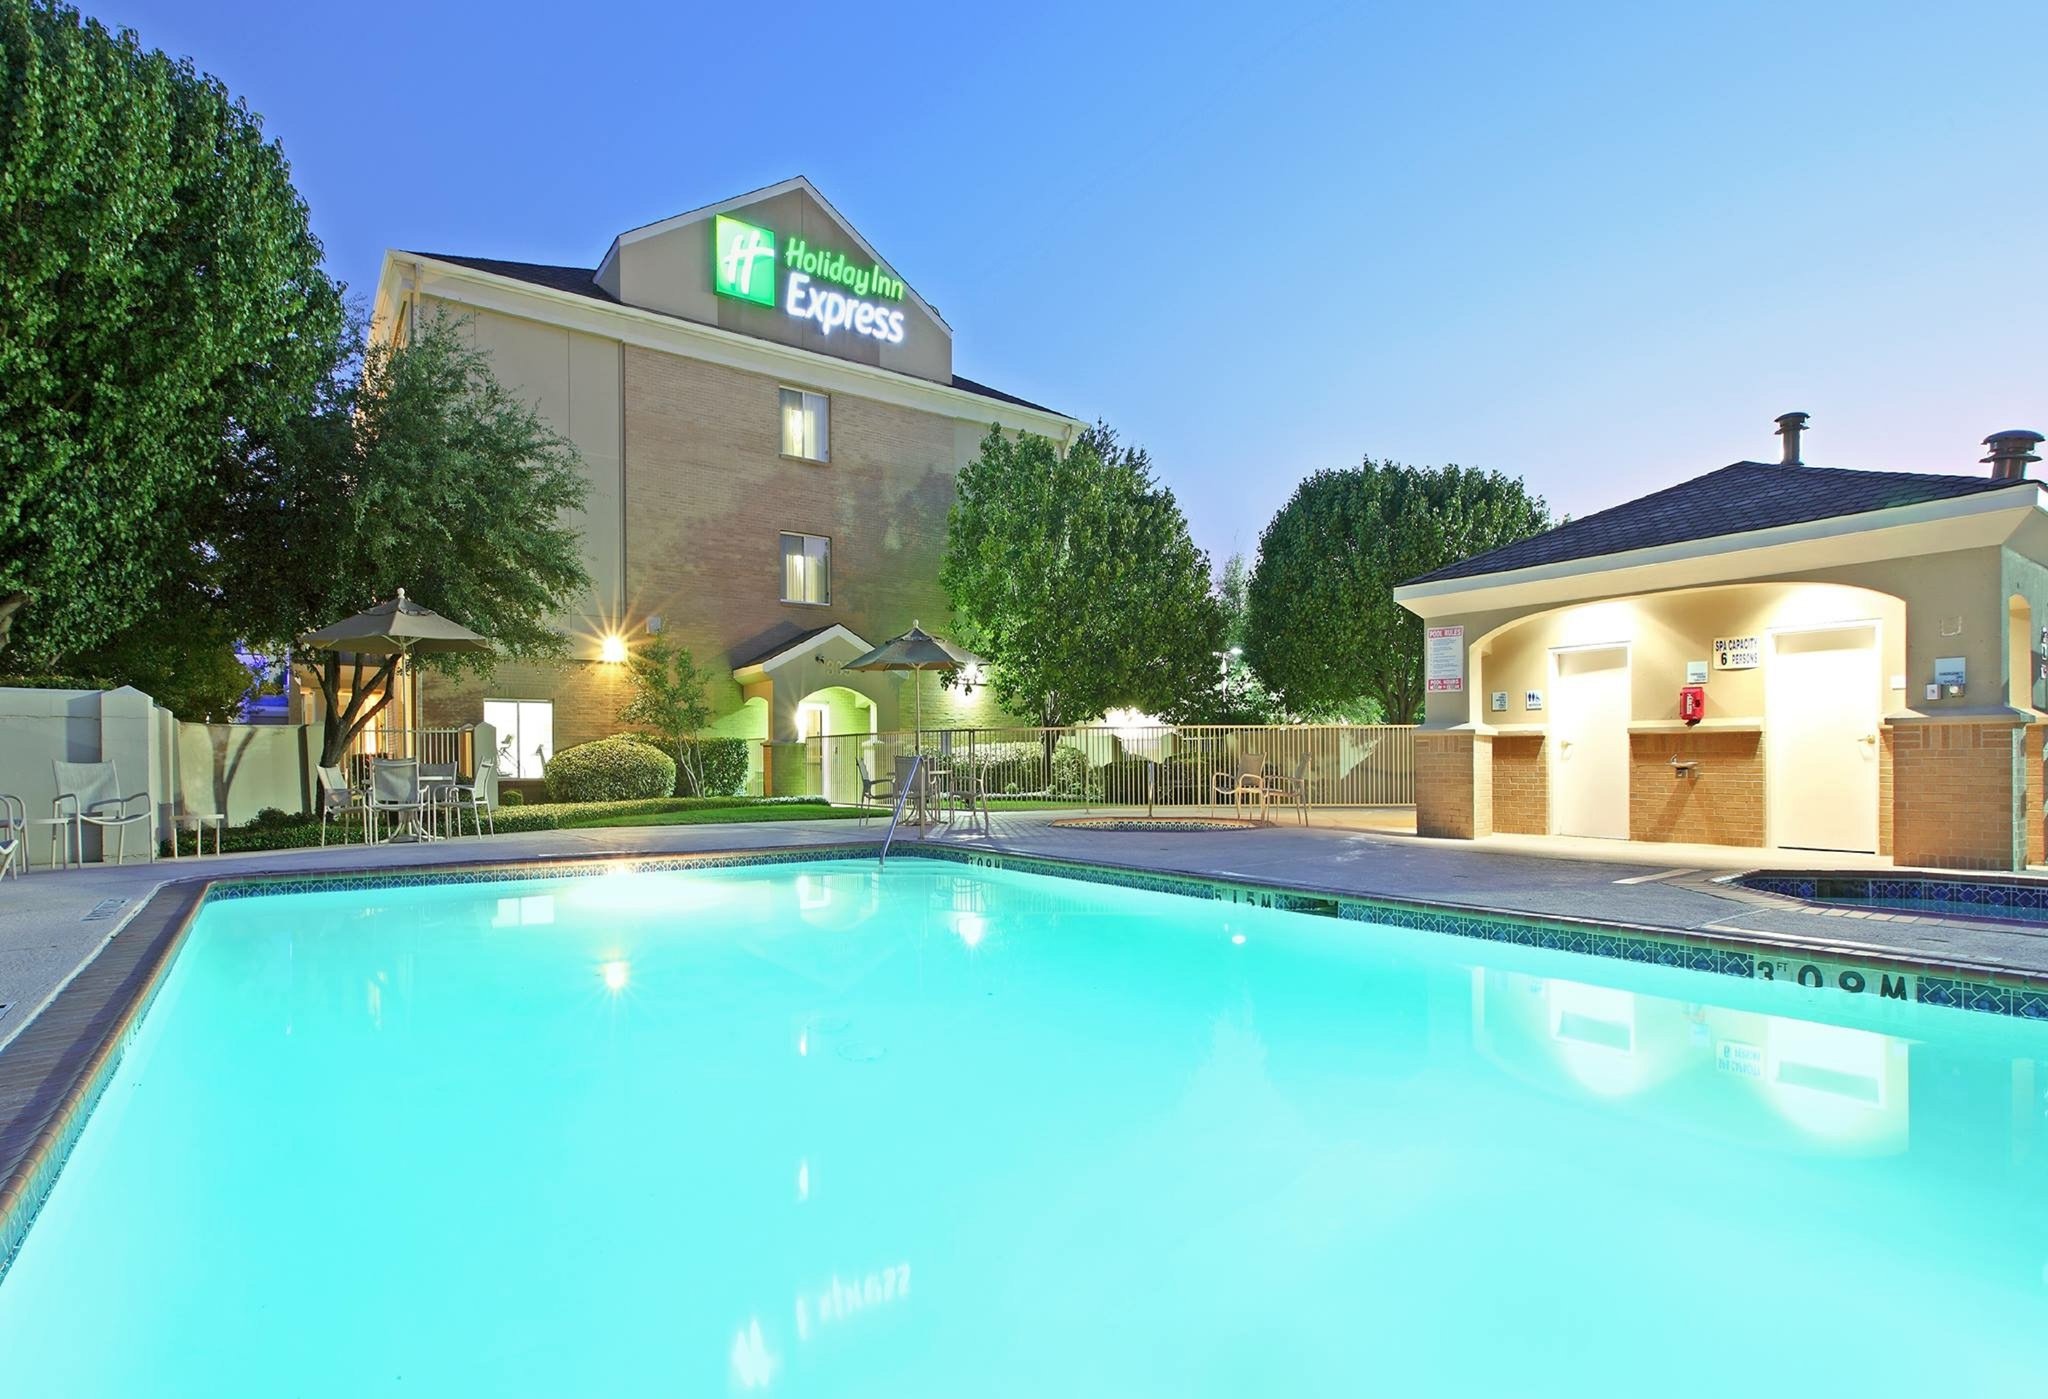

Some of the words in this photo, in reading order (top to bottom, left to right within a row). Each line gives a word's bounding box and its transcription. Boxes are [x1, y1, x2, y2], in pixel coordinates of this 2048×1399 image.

[785, 237, 870, 297] Holiday
[871, 264, 904, 301] Inn
[785, 271, 905, 344] Express
[1429, 629, 1442, 638] POOL
[1444, 628, 1461, 637] RULES
[1715, 640, 1727, 652] SPA
[1728, 637, 1758, 651] CAPACITY
[1721, 652, 1728, 666] 6
[1732, 652, 1758, 665] PERSONS
